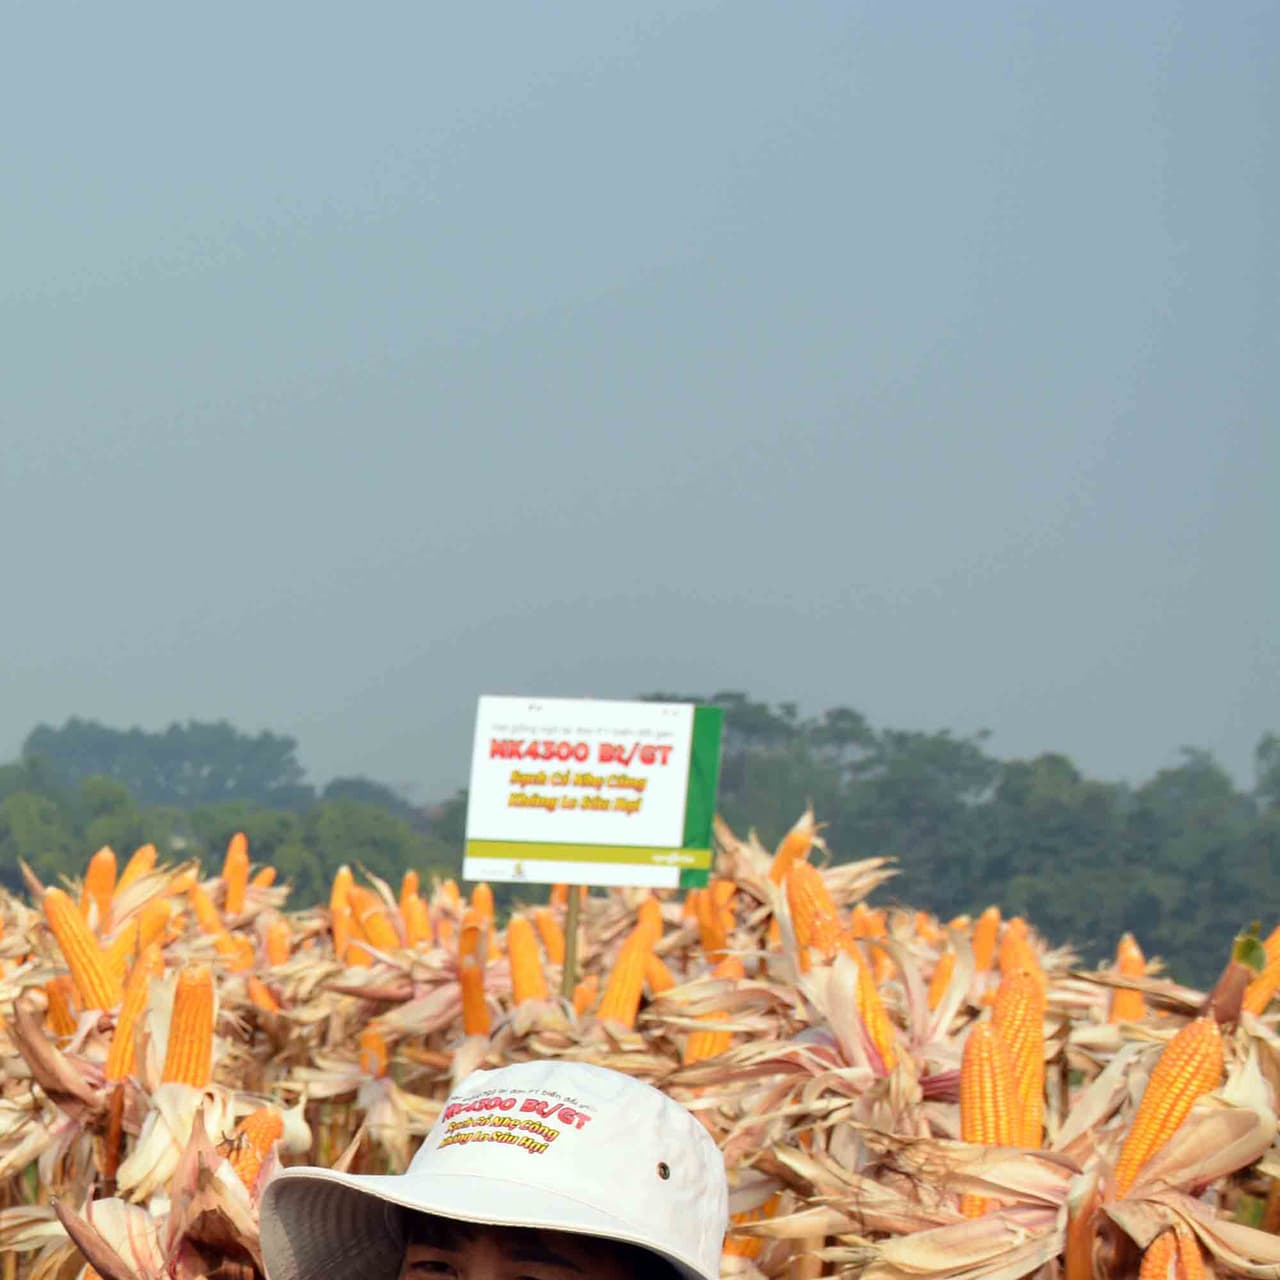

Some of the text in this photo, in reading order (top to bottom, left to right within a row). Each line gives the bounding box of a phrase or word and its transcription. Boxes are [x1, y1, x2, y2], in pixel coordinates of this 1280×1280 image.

[489, 738, 673, 767] NK4300 Bt/GT
[520, 1098, 592, 1130] Bt/GT
[491, 1116, 519, 1131] Nhẹ
[519, 1119, 560, 1142] Công
[518, 1136, 550, 1154] Hại
